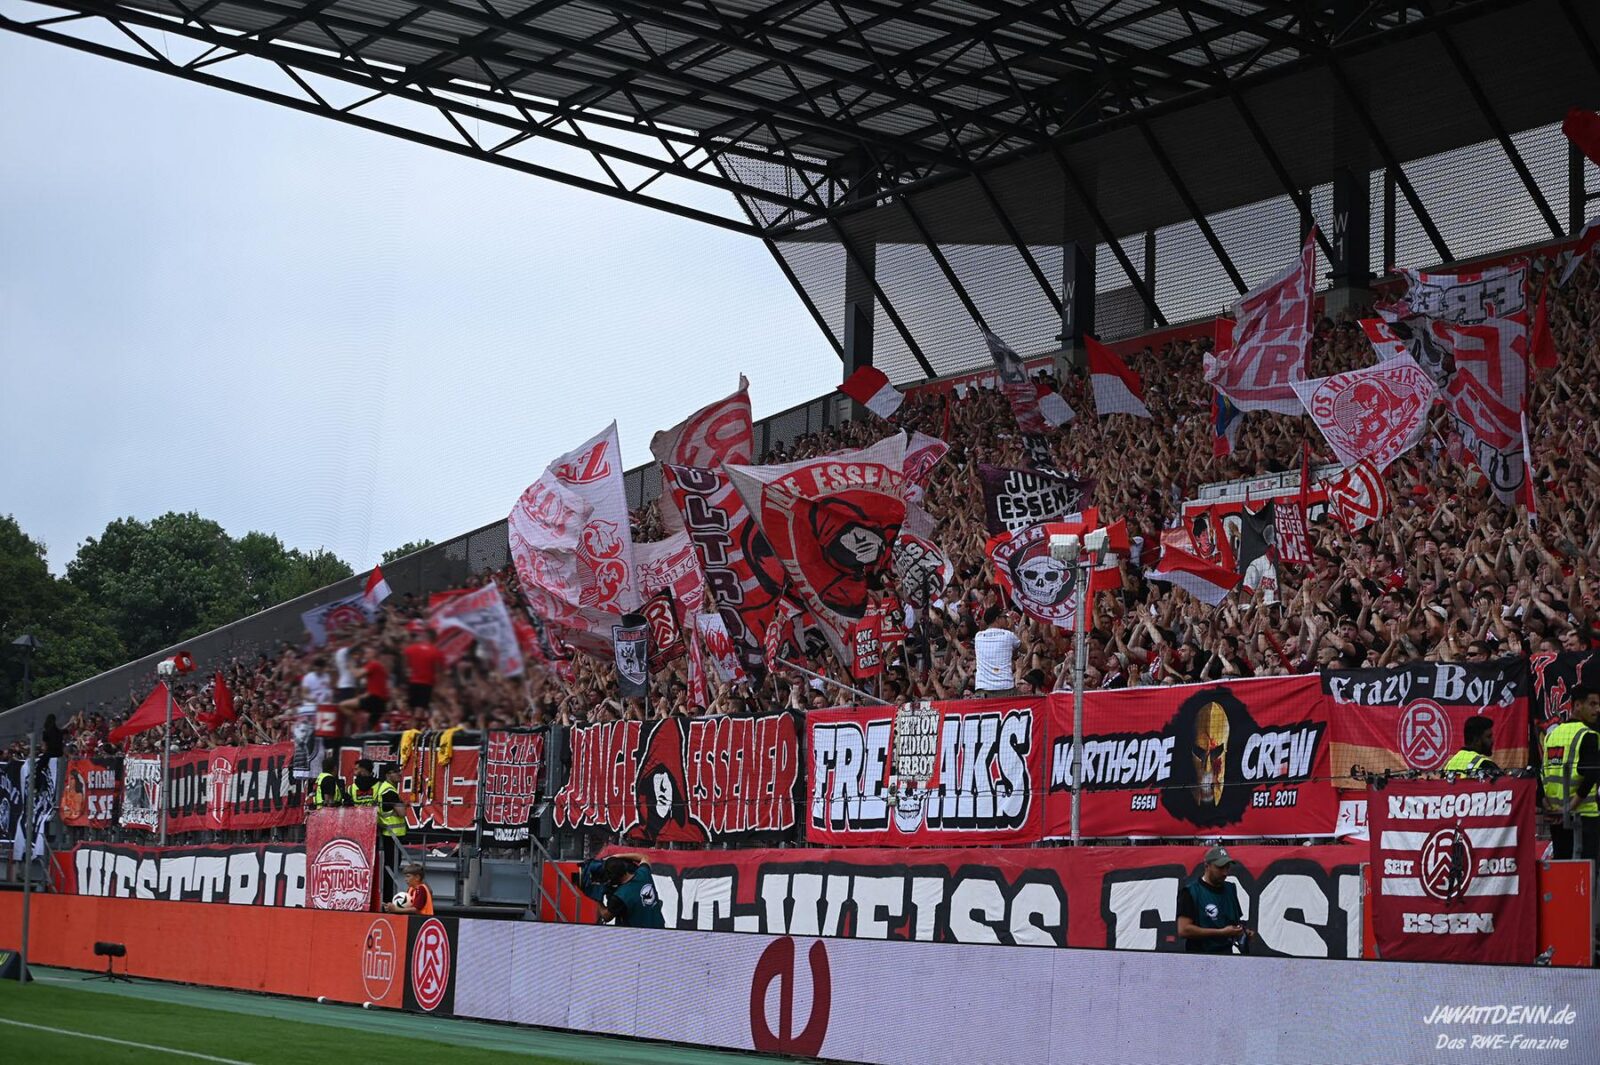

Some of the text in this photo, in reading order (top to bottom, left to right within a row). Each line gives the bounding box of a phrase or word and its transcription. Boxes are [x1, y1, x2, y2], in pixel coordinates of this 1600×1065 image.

[1334, 215, 1348, 233] W
[1336, 239, 1344, 261] 1
[1063, 281, 1076, 300] W
[1064, 303, 1072, 325] 1
[1051, 728, 1318, 787] NORTHSIDE CREW
[553, 720, 643, 832] JUNGE
[687, 712, 798, 833] ESSENER
[813, 709, 1032, 832] FREAKS
[1131, 794, 1158, 810] ESSEN
[1252, 790, 1297, 808] EST. 2011
[1388, 790, 1513, 819] KATEGORIE
[1384, 858, 1517, 876] SEIT 2015
[1403, 913, 1494, 934] ESSEN
